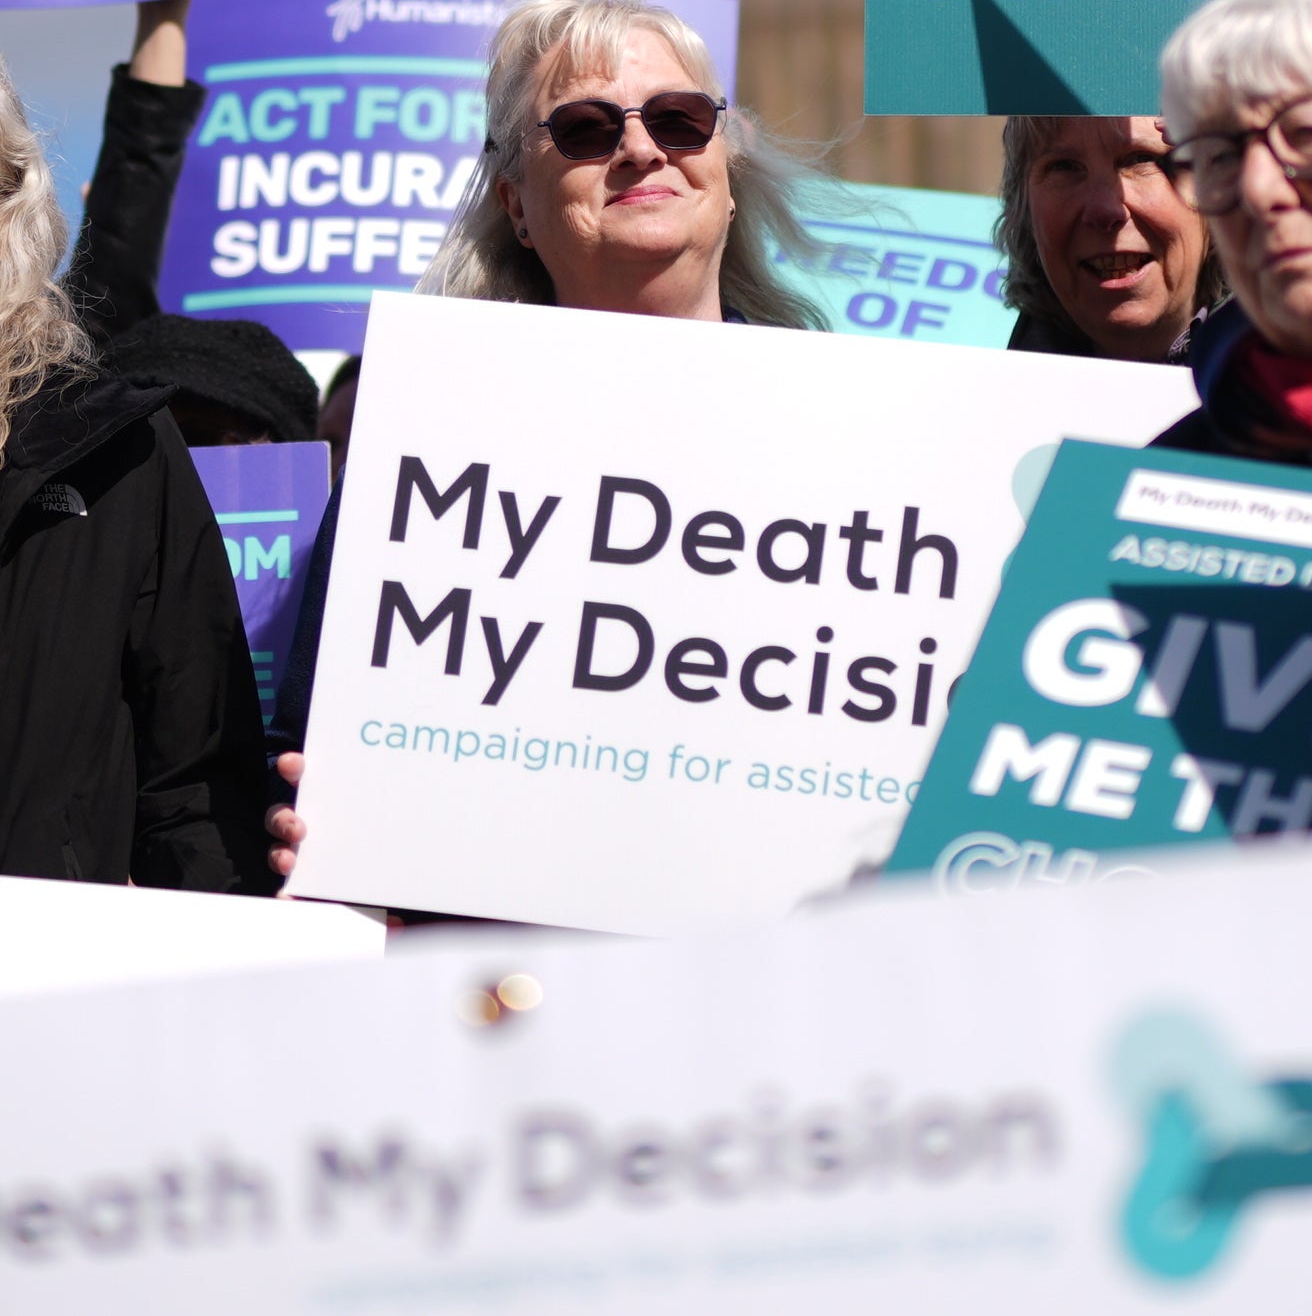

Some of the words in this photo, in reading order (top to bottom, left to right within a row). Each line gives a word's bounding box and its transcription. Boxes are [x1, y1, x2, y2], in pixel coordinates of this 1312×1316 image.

[198, 87, 346, 147] ACT
[355, 87, 491, 145] FOR
[217, 150, 491, 211] INCURA
[210, 216, 445, 278] SUFFE
[846, 292, 952, 338] OF
[42, 501, 70, 513] FACE
[43, 484, 66, 494] THE
[1139, 484, 1170, 504] My
[1175, 491, 1243, 515] Death
[1249, 501, 1278, 522] My
[388, 455, 563, 579] My
[589, 474, 960, 600] Death
[1108, 534, 1297, 588] ASSISTED
[370, 580, 544, 706] My
[572, 601, 963, 727] Decisi
[359, 718, 650, 783] campaigning
[668, 744, 732, 784] for
[970, 722, 1152, 820] ME
[510, 1079, 1061, 1211] Decision
